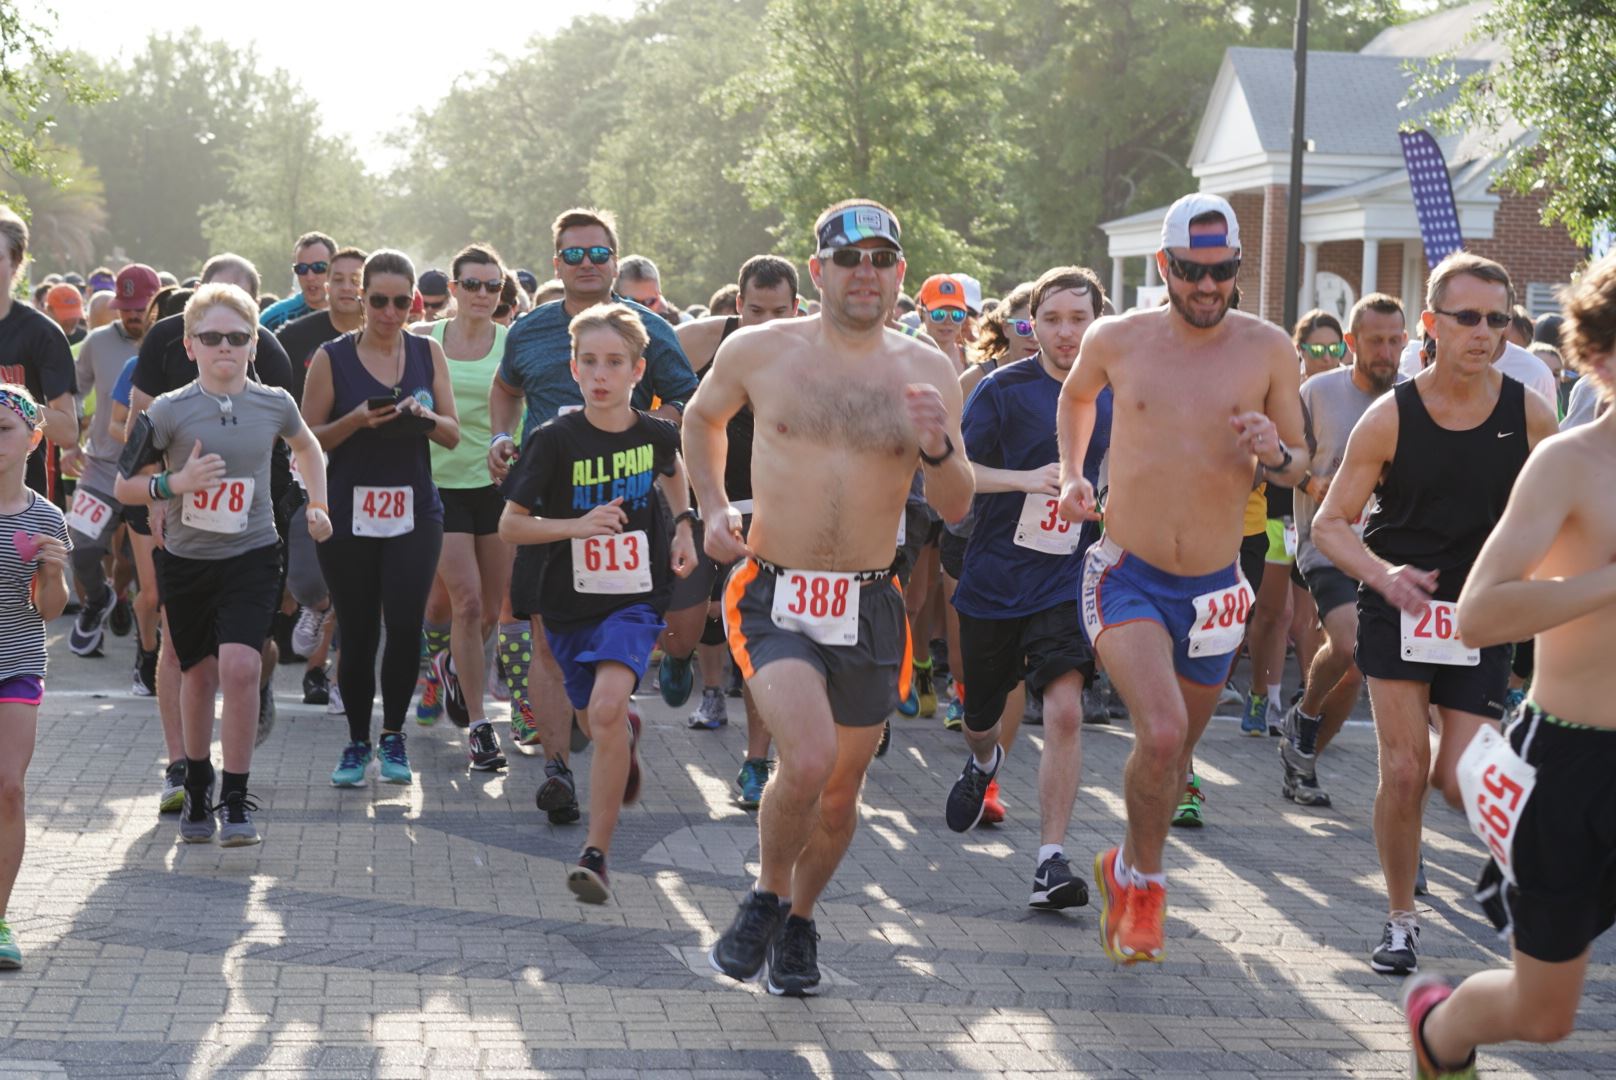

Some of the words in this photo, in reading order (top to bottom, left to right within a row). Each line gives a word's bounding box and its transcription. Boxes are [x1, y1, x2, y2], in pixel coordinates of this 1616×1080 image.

[572, 456, 611, 486] ALL
[612, 443, 654, 480] PAIN
[73, 493, 107, 524] 276
[193, 482, 244, 512] 578
[362, 490, 405, 519] 428
[572, 483, 609, 510] ALL
[612, 470, 653, 502] GAIN
[584, 535, 639, 572] 613
[787, 574, 849, 618] 388
[1414, 603, 1460, 640] 26
